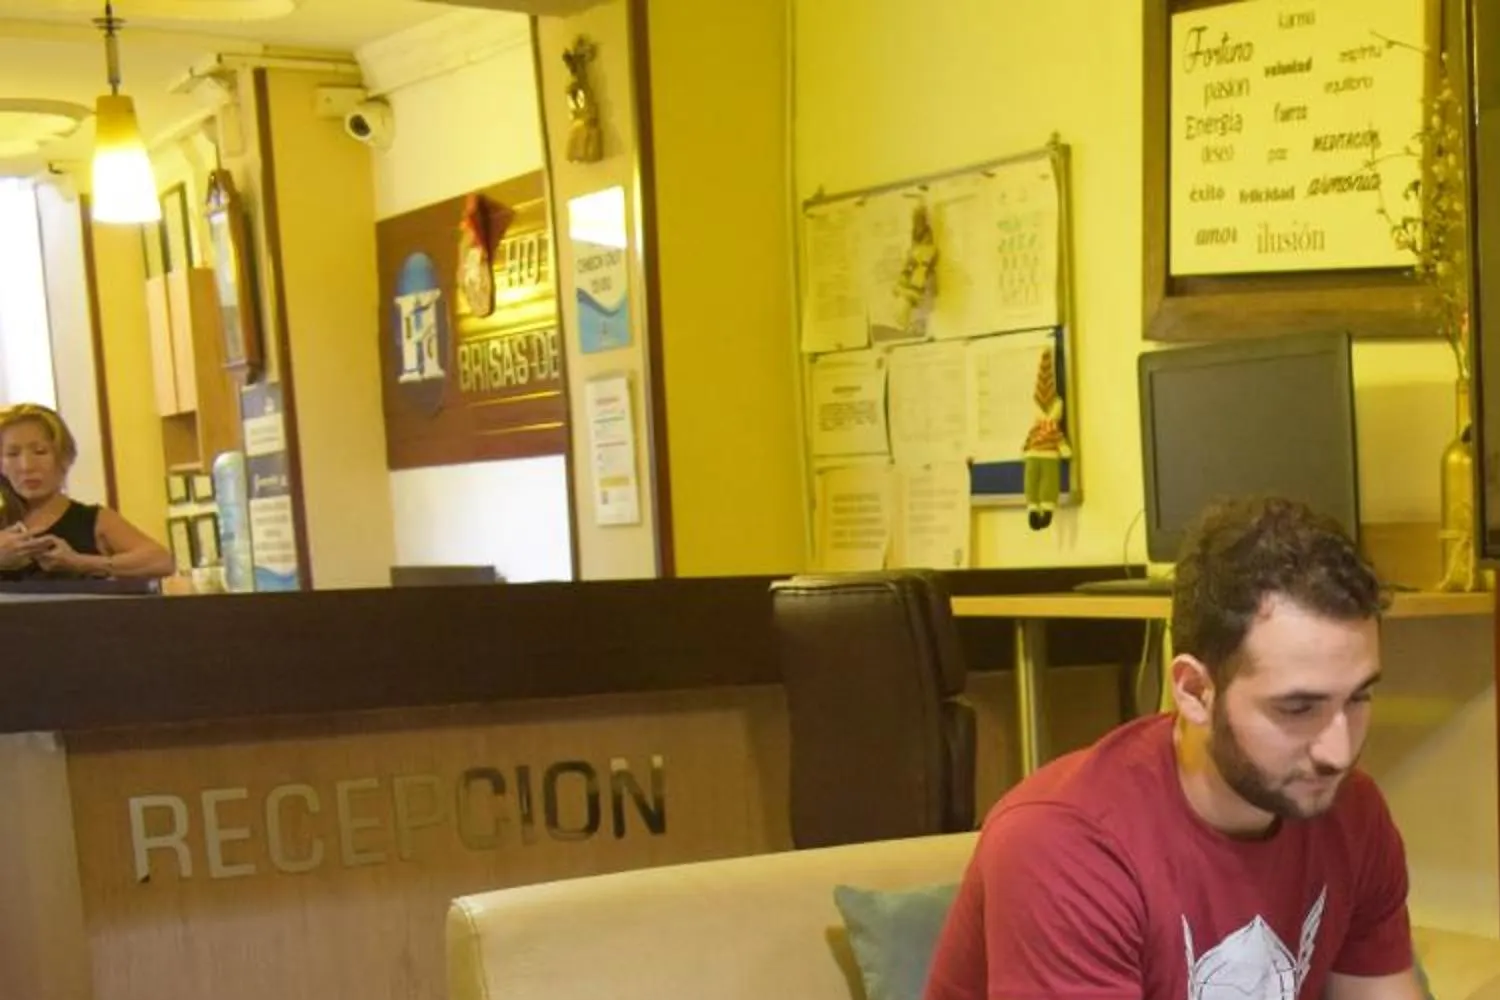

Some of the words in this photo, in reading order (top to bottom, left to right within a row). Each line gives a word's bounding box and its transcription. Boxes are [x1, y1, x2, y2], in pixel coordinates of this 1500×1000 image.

[1195, 226, 1238, 246] amor
[458, 334, 530, 393] BRISAS
[128, 755, 668, 883] RECEPCION
